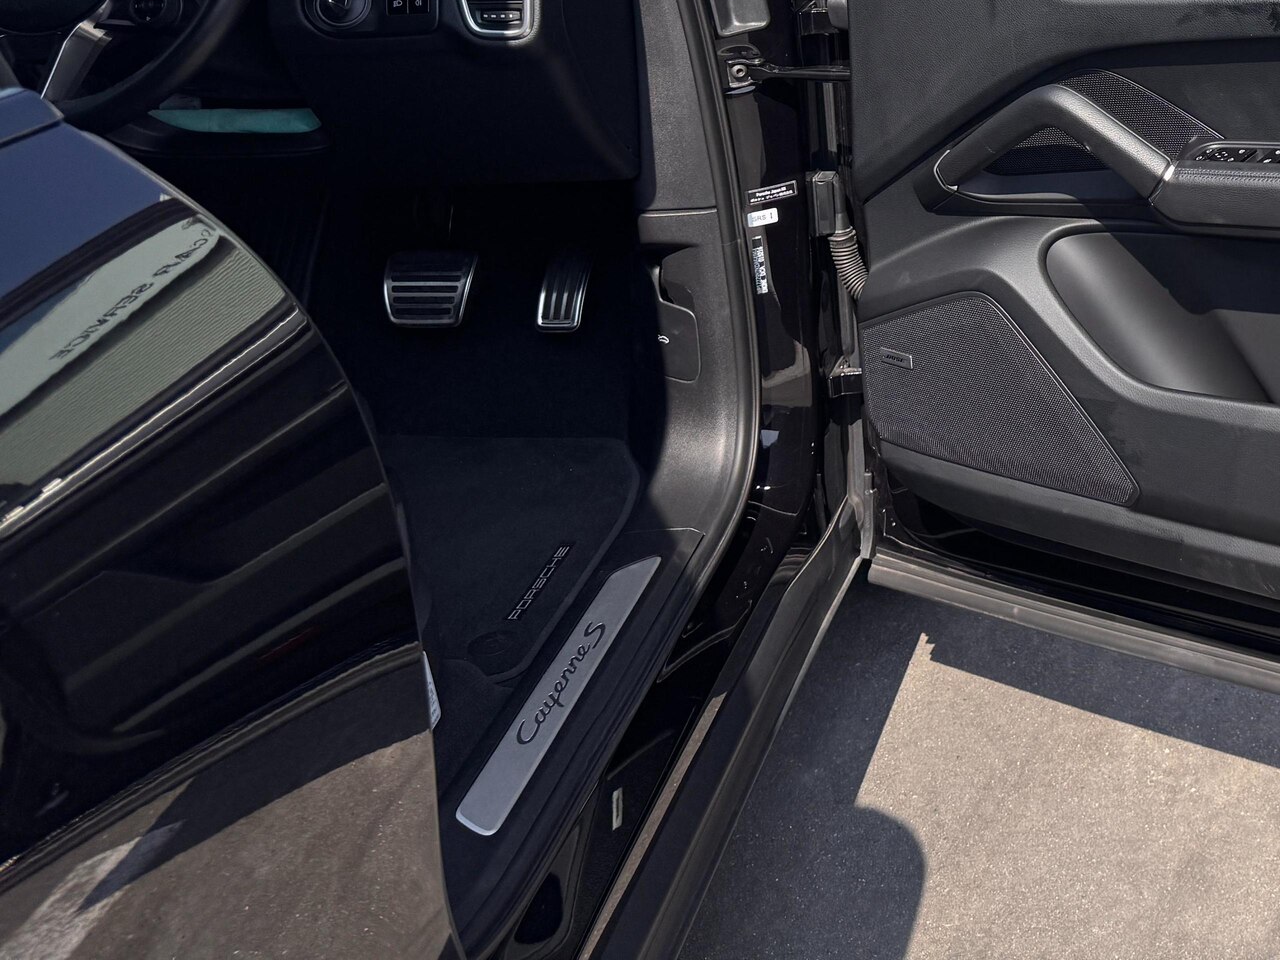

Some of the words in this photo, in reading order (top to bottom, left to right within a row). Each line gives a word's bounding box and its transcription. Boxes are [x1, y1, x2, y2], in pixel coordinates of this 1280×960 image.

[507, 546, 570, 620] PORSCHE
[516, 642, 591, 745] Cayenne
[583, 620, 606, 649] S
